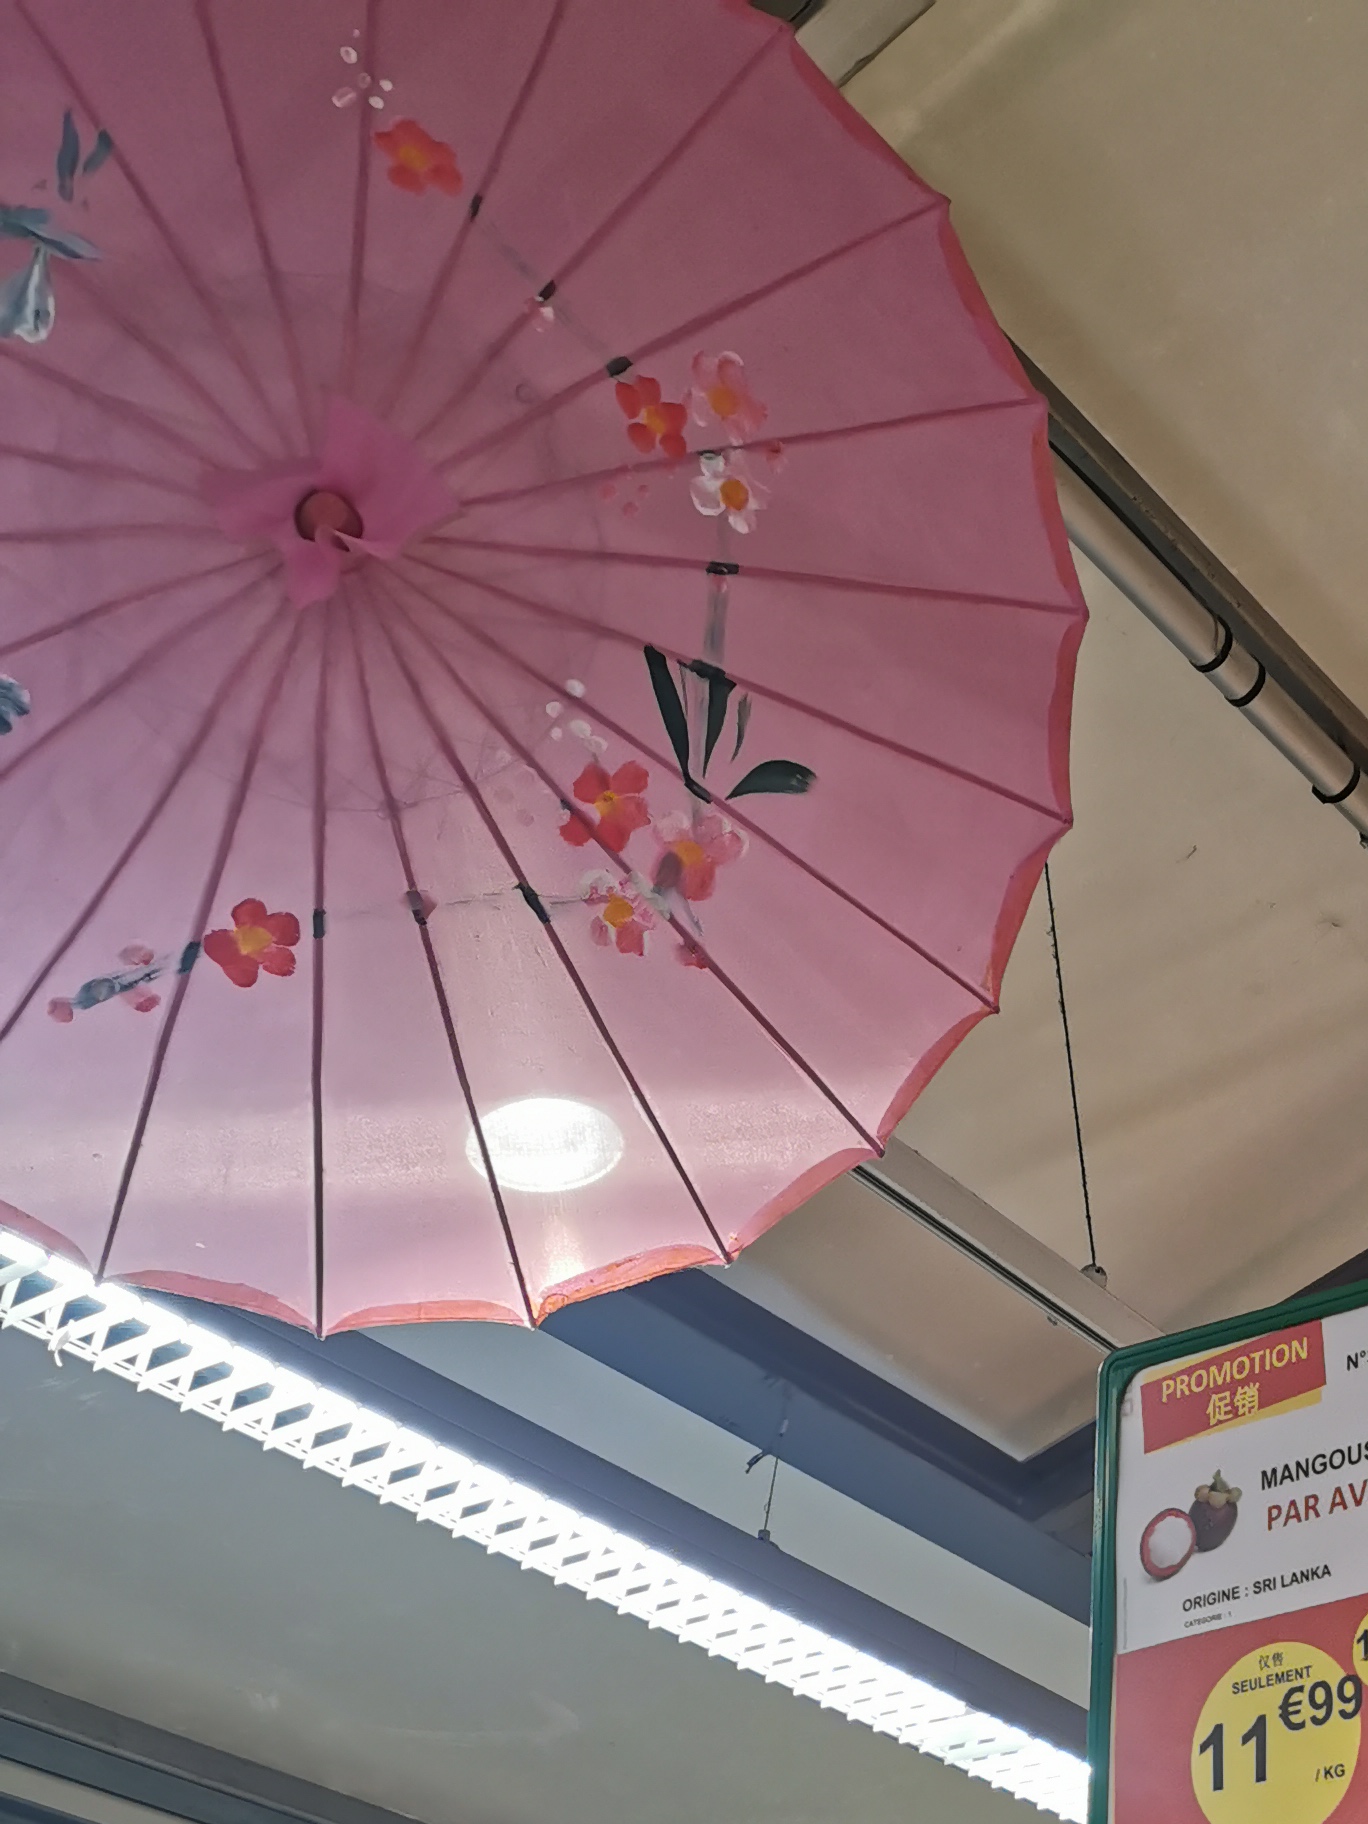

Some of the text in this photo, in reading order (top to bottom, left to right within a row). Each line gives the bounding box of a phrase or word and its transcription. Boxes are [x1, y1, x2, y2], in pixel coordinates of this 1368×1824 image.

[1161, 1336, 1308, 1403] PROMOTION
[1206, 1382, 1260, 1427] 促销
[1267, 1494, 1321, 1531] PAR
[1182, 1564, 1332, 1613] ORIGINE SRI LANKA
[1231, 1664, 1313, 1695] SEULEMENT
